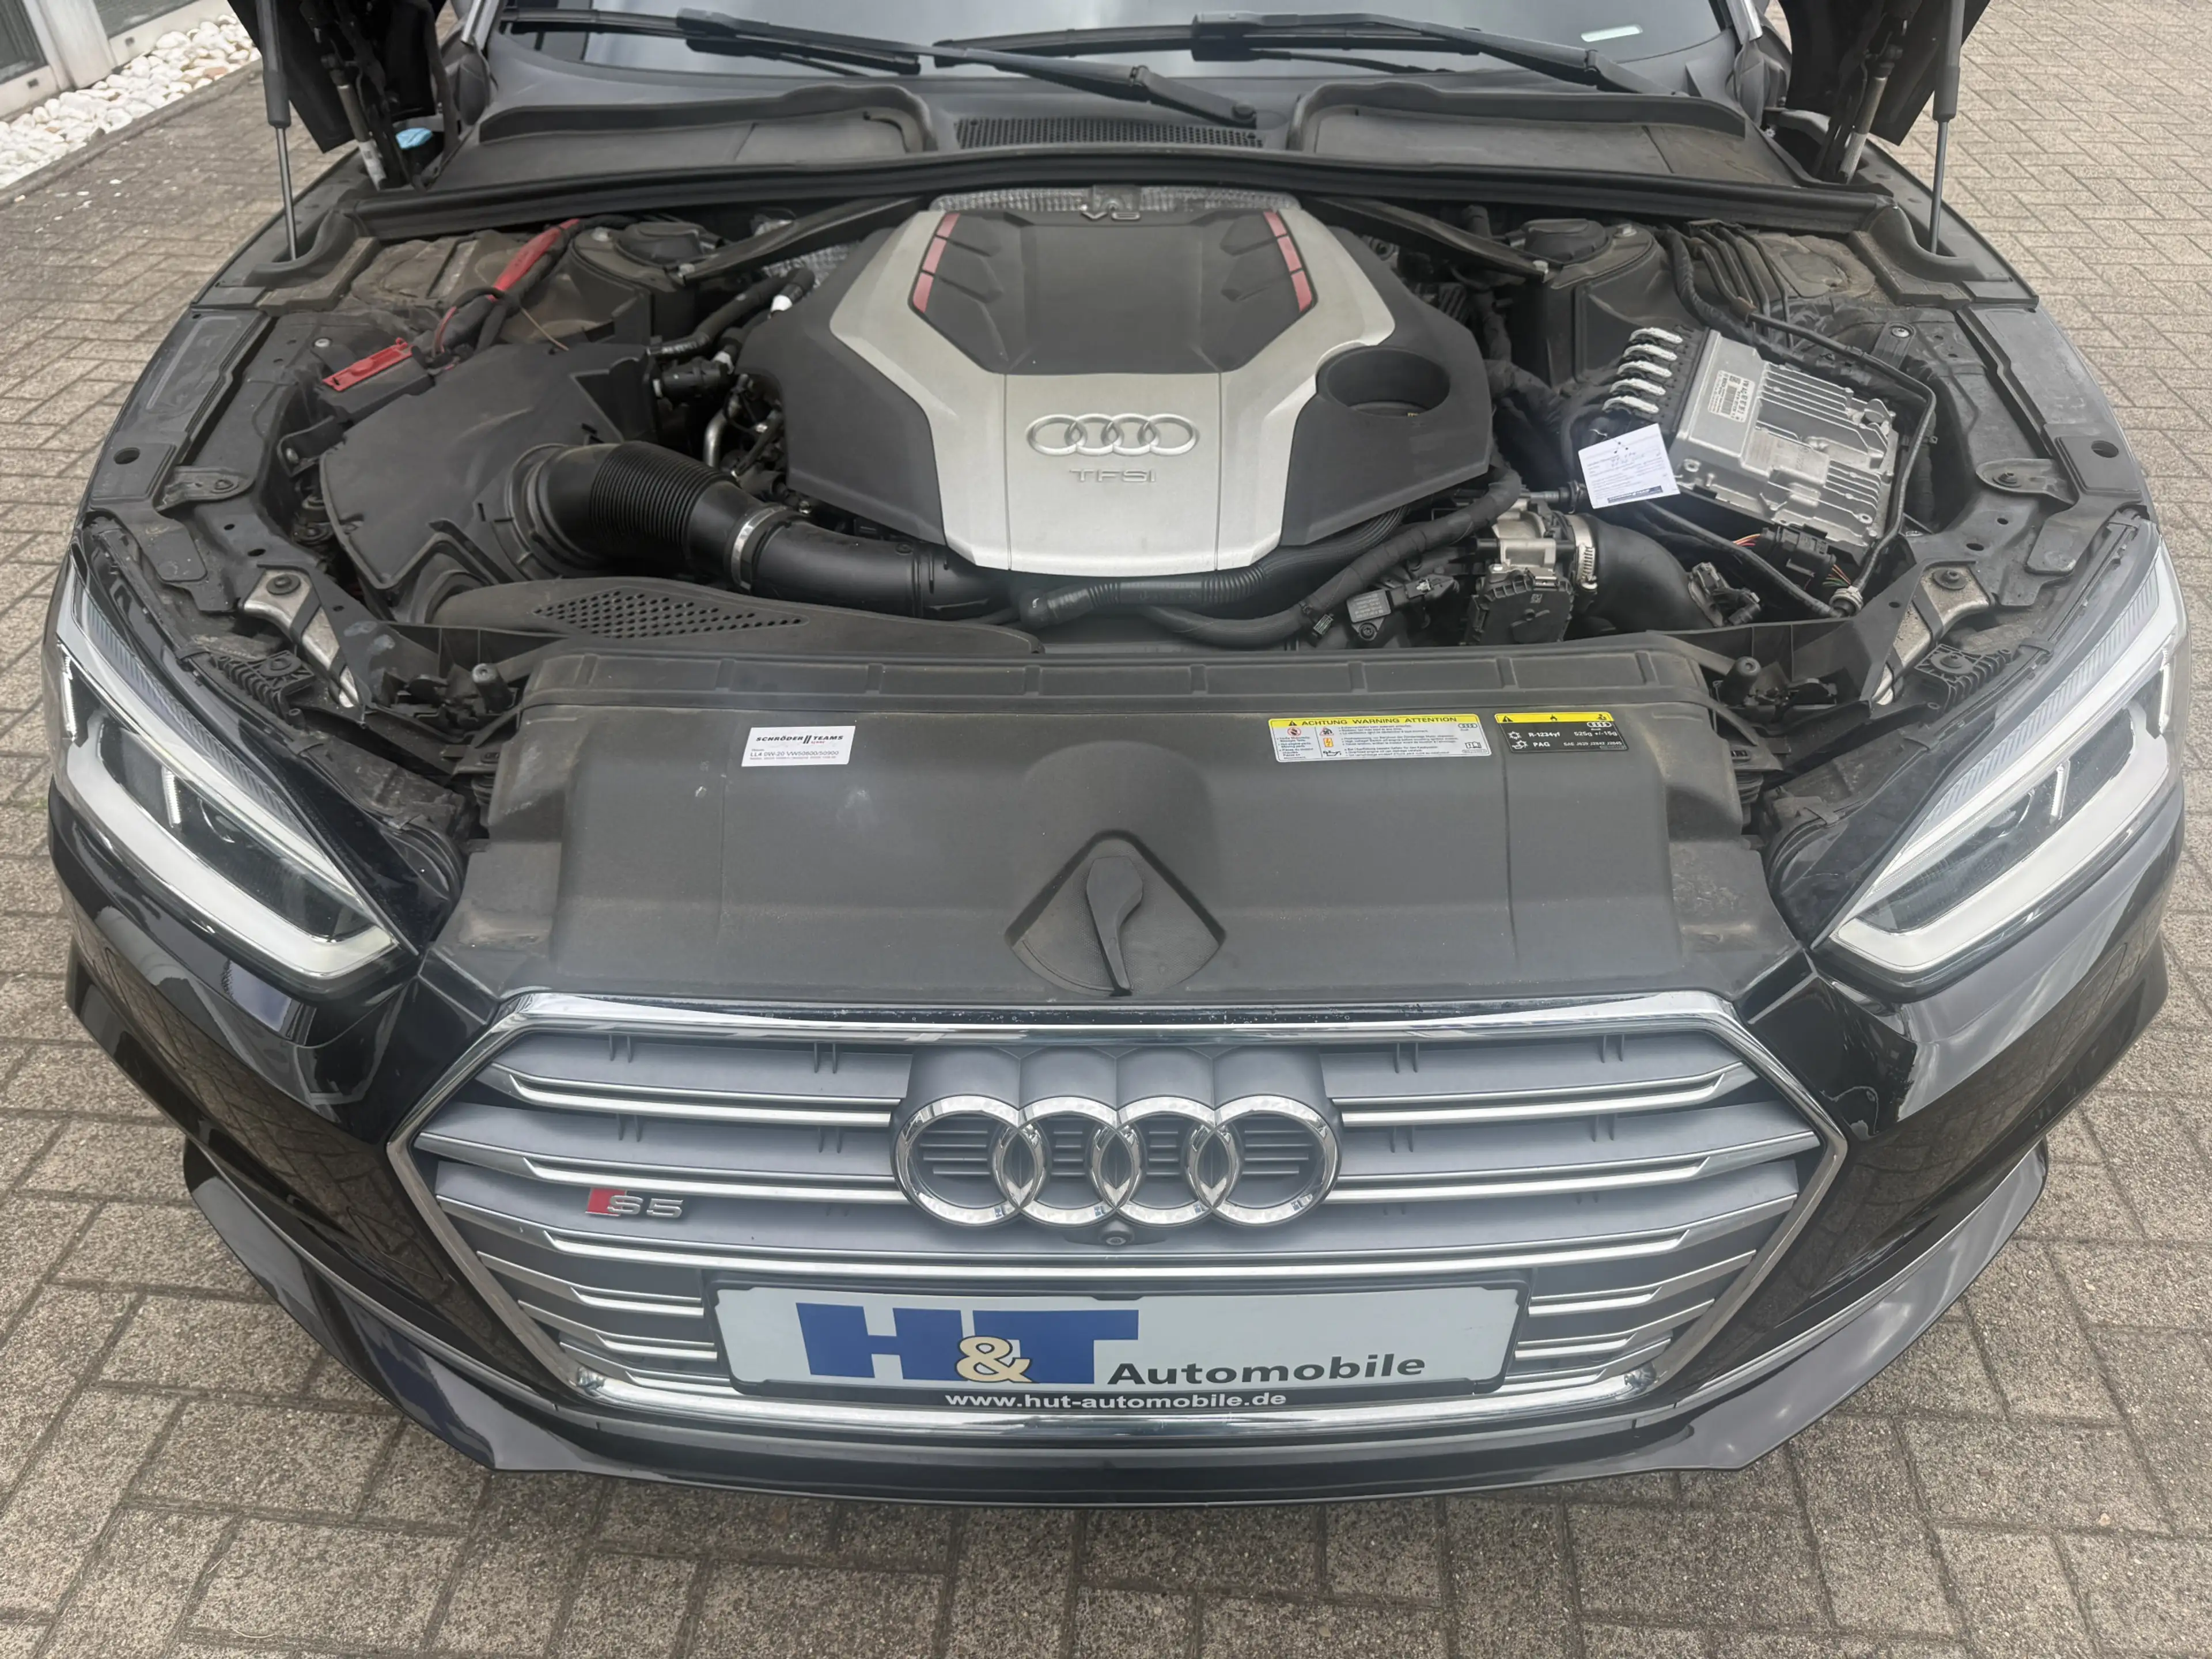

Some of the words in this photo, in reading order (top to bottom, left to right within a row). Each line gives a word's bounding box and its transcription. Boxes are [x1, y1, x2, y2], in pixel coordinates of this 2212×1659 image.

[1069, 469, 1156, 483] TFSI
[607, 1195, 683, 1218] S5
[796, 1302, 1139, 1384] H&T
[1107, 1354, 1426, 1385] Automobile
[945, 1392, 1287, 1409] www.hut-automobile.de
